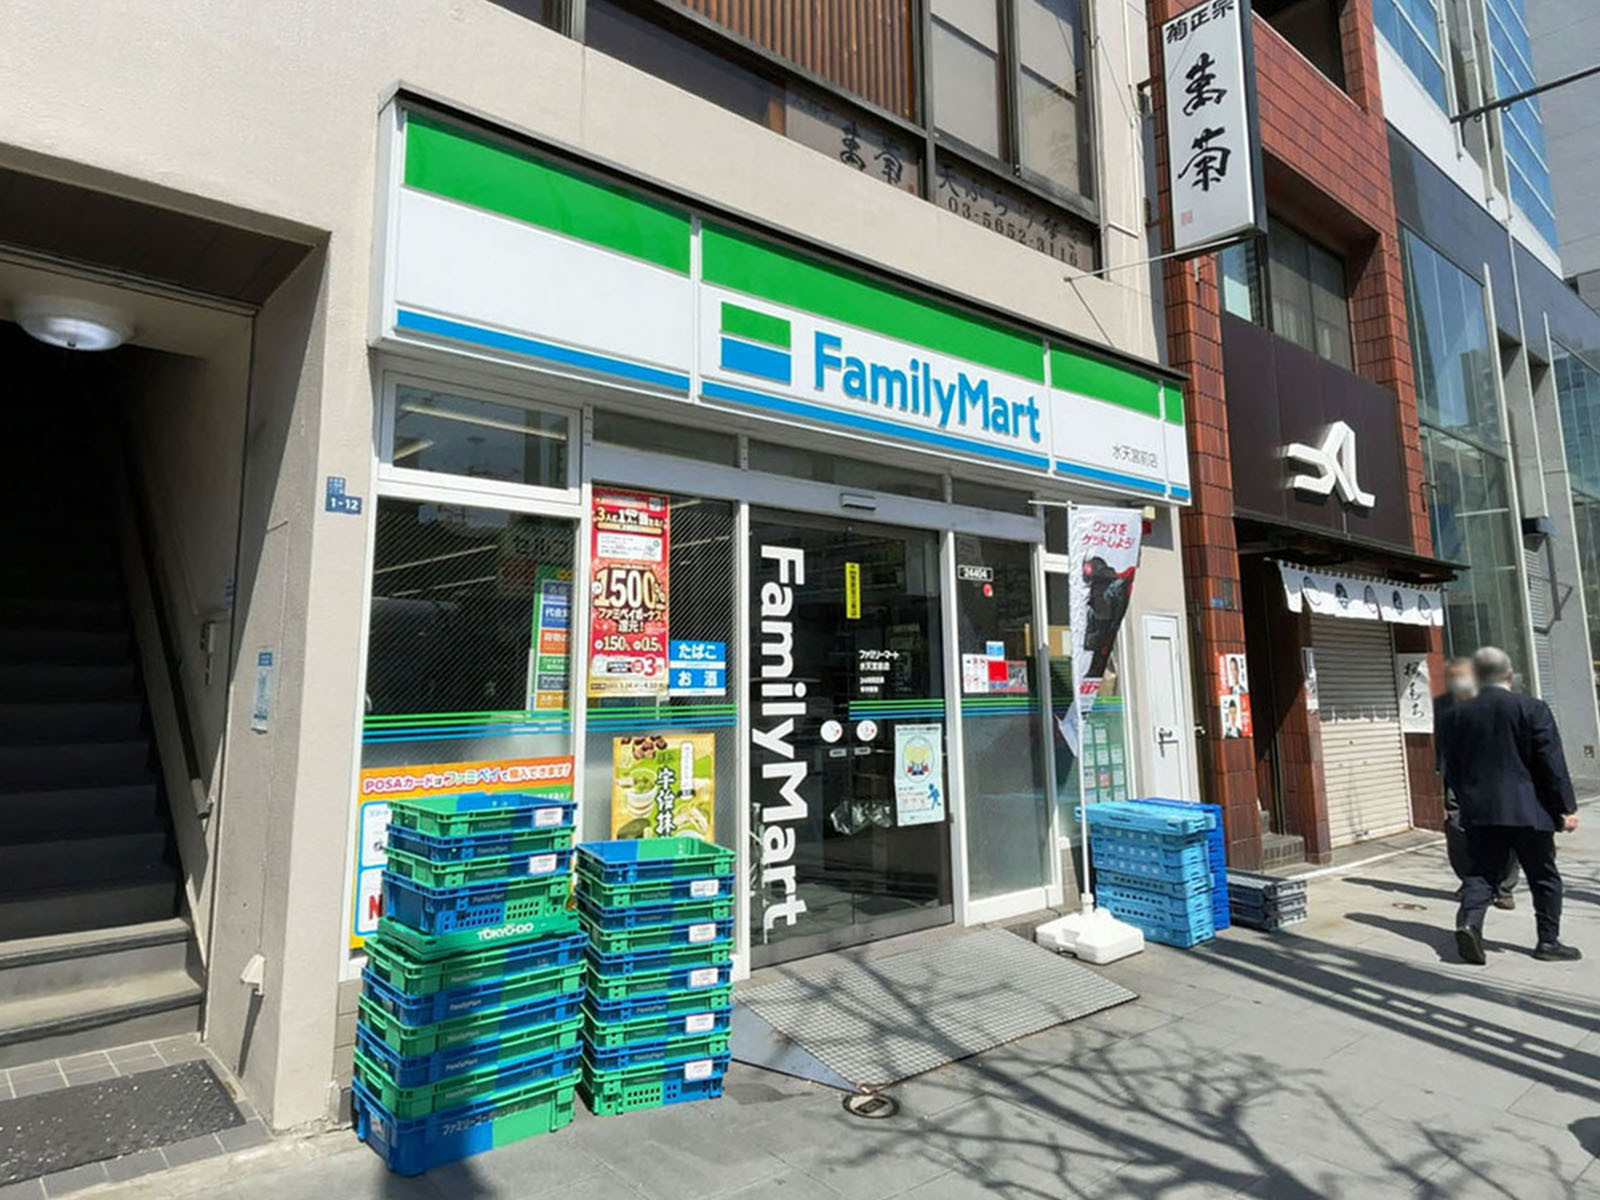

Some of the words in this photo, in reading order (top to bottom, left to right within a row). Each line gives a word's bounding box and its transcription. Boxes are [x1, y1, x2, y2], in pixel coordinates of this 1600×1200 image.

[813, 331, 1041, 443] FamilyMart
[1111, 444, 1158, 469] 水天宮前店
[331, 497, 359, 511] 1-12
[678, 642, 718, 660] たばこ
[752, 545, 807, 930] FamilyMart
